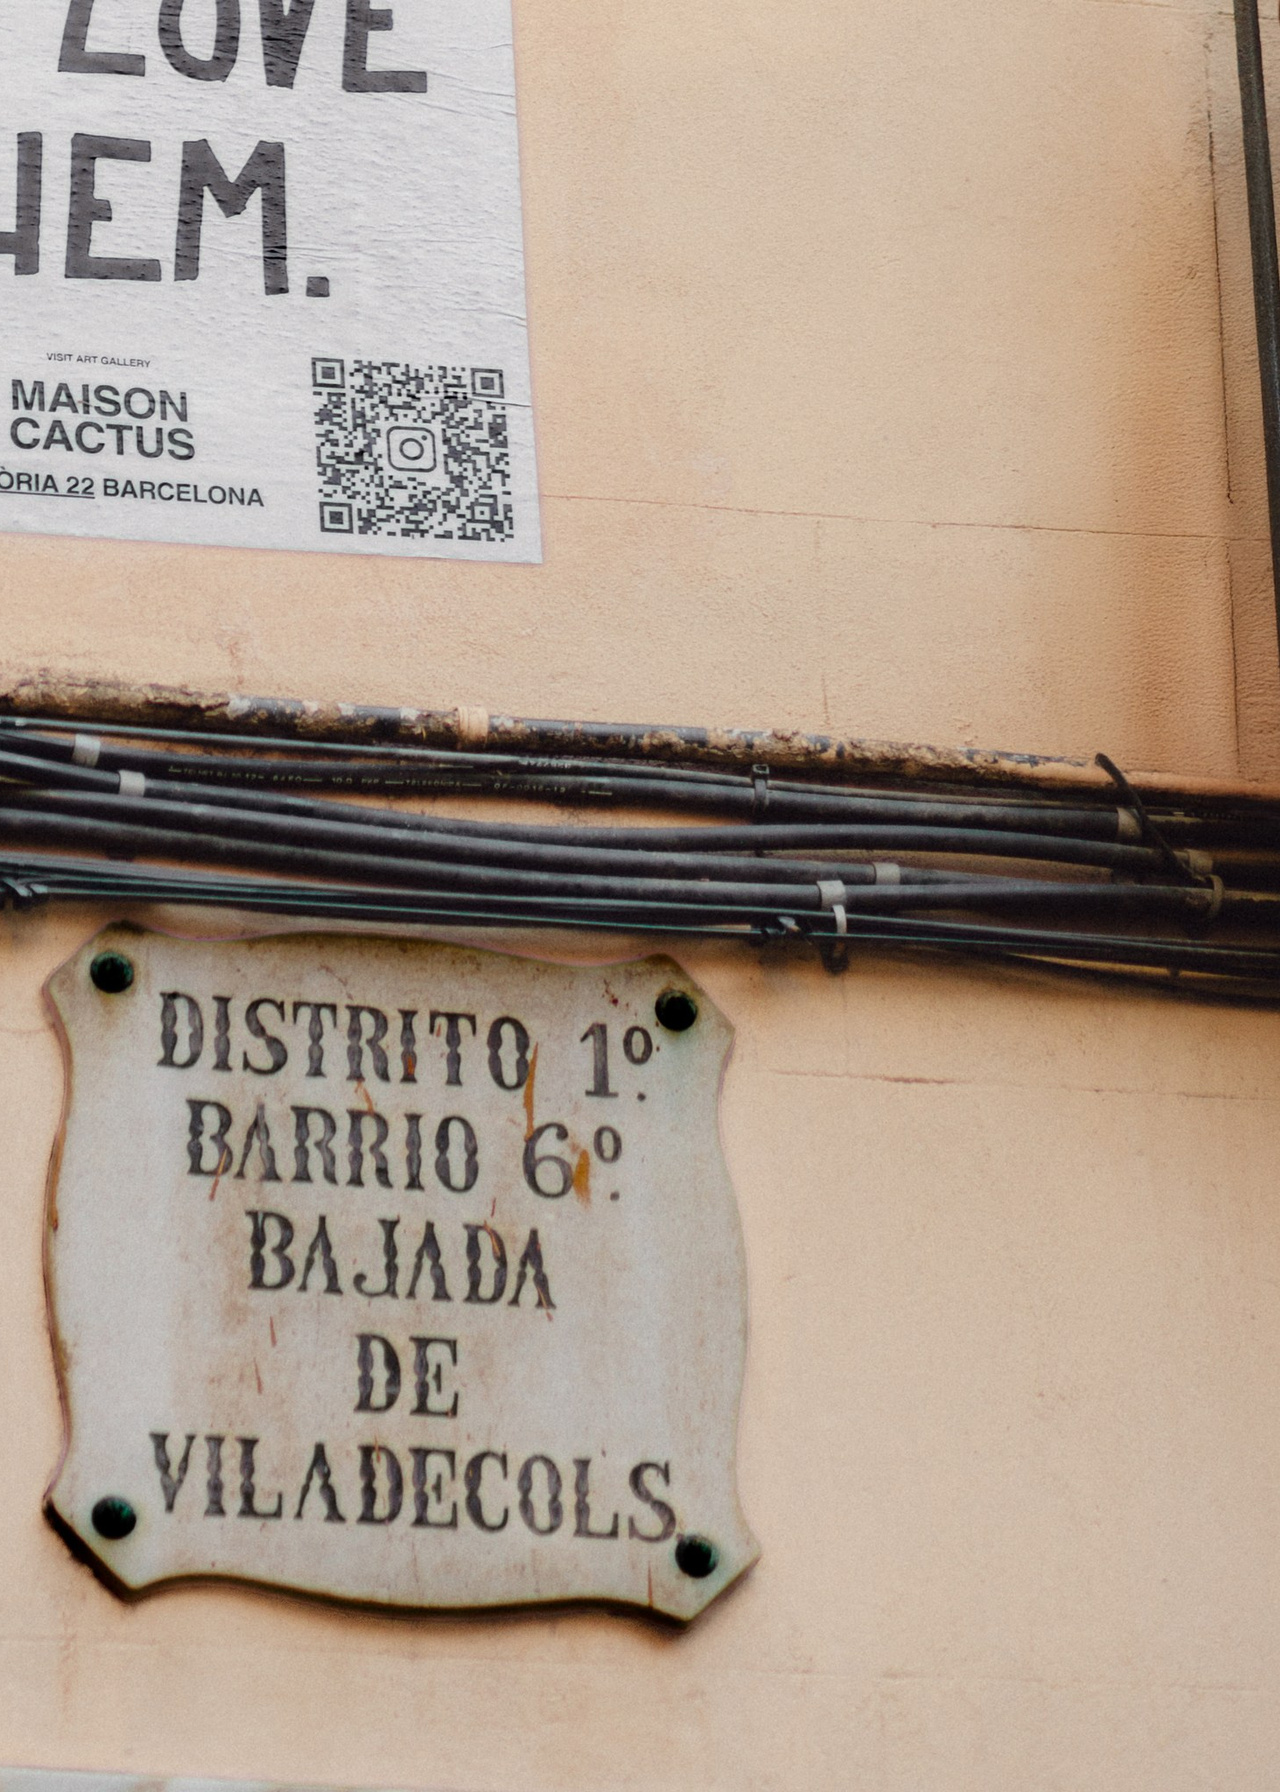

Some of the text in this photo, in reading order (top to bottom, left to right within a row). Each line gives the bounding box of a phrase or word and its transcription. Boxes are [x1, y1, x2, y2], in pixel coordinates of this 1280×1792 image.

[46, 352, 151, 368] VISIT ART GALLERY
[11, 378, 188, 423] MAISON
[9, 416, 196, 461] CACTUS
[66, 475, 96, 495] 22
[102, 477, 265, 508] BARCELONA
[157, 991, 531, 1091] DISTRITO
[185, 1098, 480, 1194] BARRIO
[246, 1211, 557, 1309] BAJADA
[353, 1334, 460, 1418] DE
